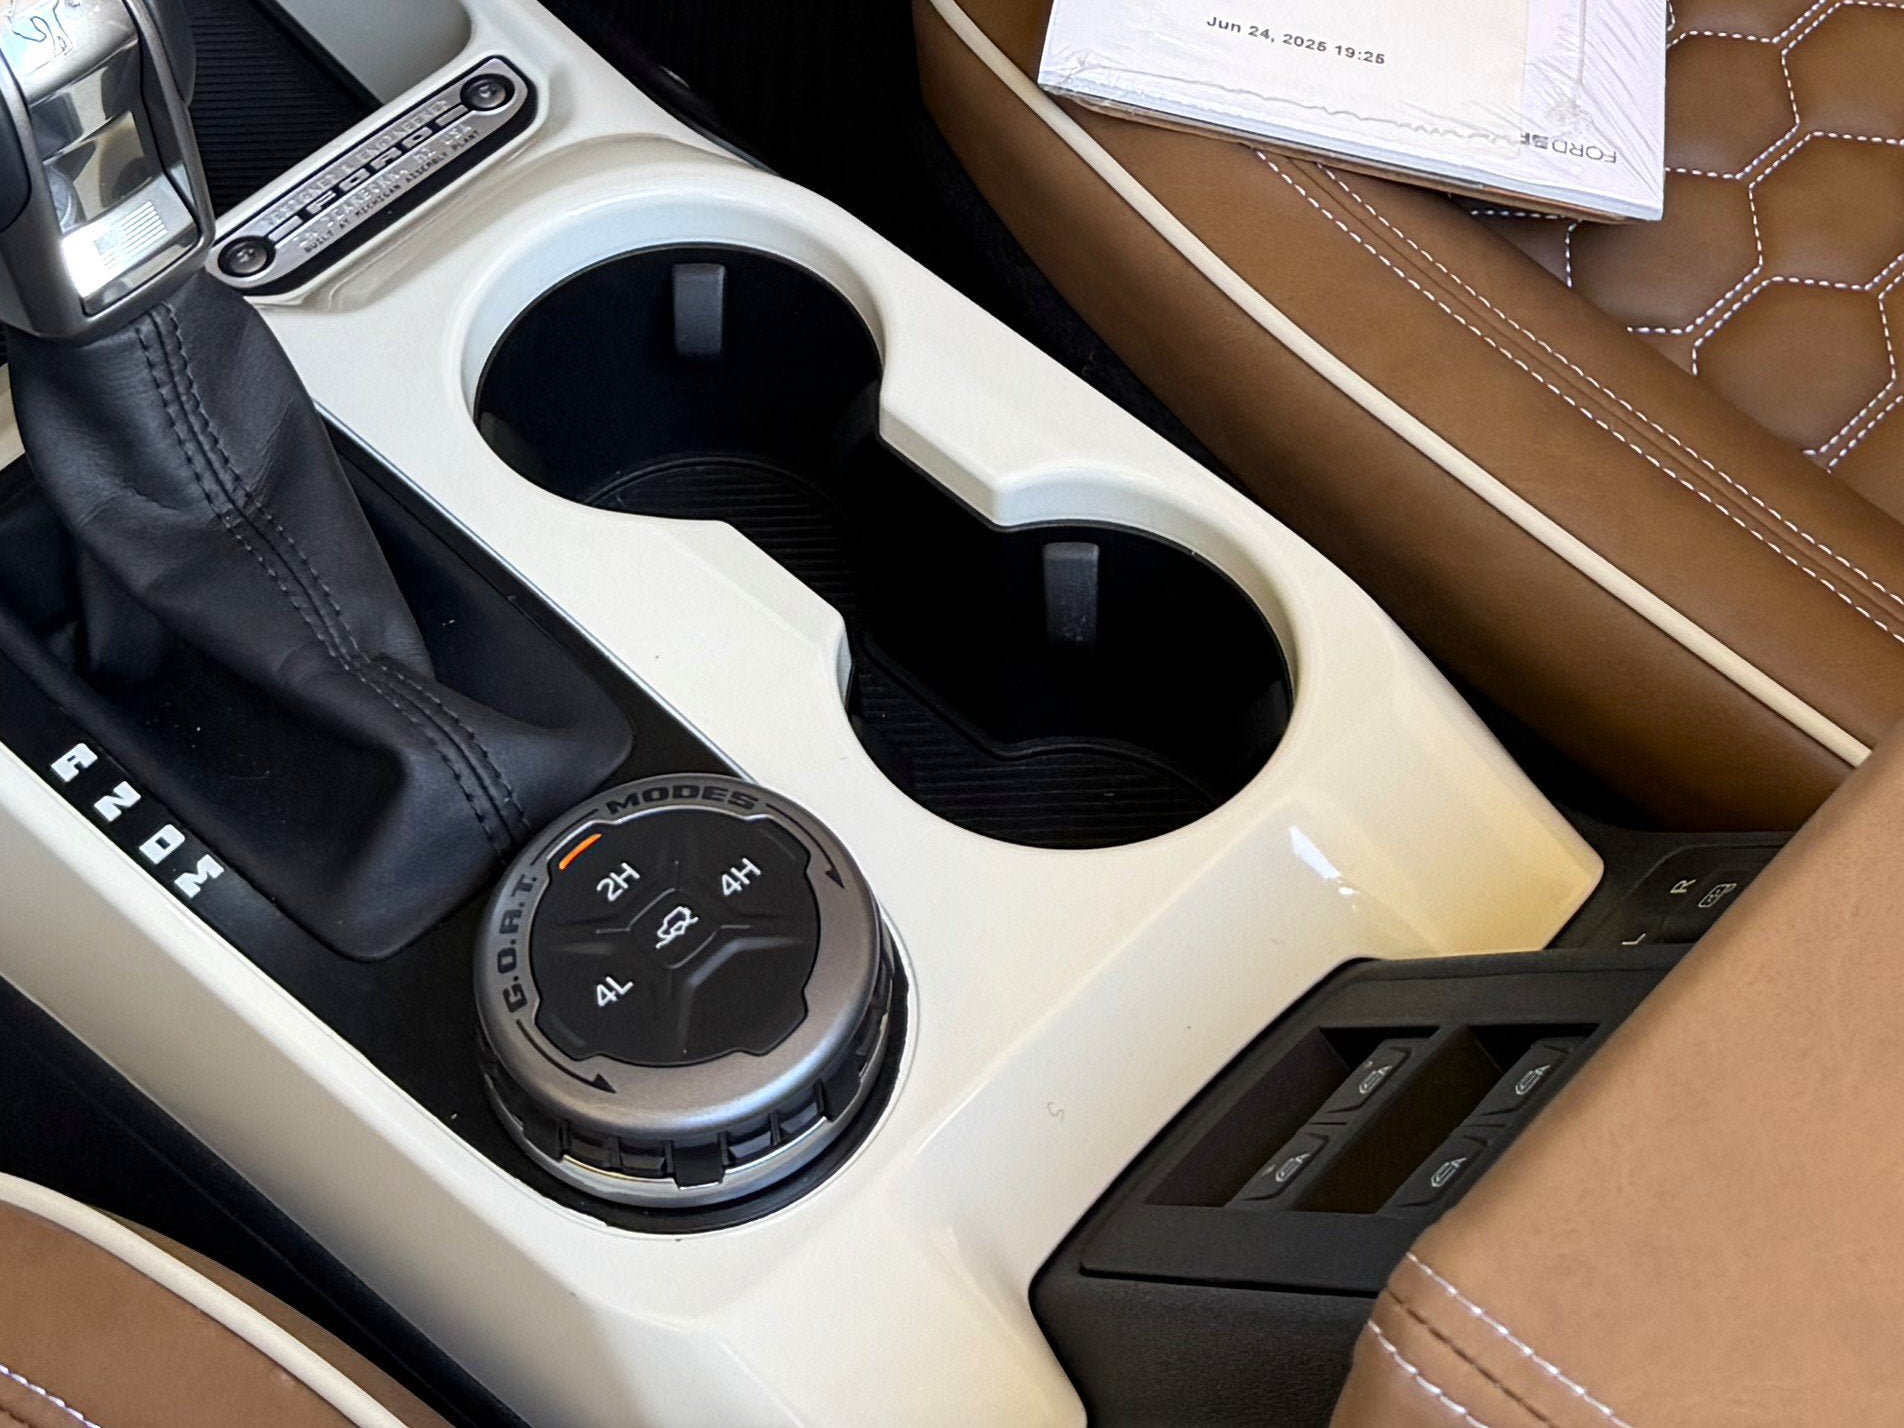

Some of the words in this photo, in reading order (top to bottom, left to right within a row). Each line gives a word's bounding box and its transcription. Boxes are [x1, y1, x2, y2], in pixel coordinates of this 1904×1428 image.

[1206, 16, 1242, 33] Jun
[1248, 25, 1275, 43] 24,
[304, 124, 434, 216] FORD
[1551, 139, 1617, 164] FORD
[606, 784, 760, 815] MODES
[50, 742, 98, 783] R
[94, 780, 142, 822] N
[139, 823, 186, 865] D
[174, 853, 225, 899] M
[596, 862, 641, 902] 2H
[720, 857, 762, 896] 4H
[497, 872, 538, 1013] G.O.A.T.
[595, 976, 634, 1007] 4L
